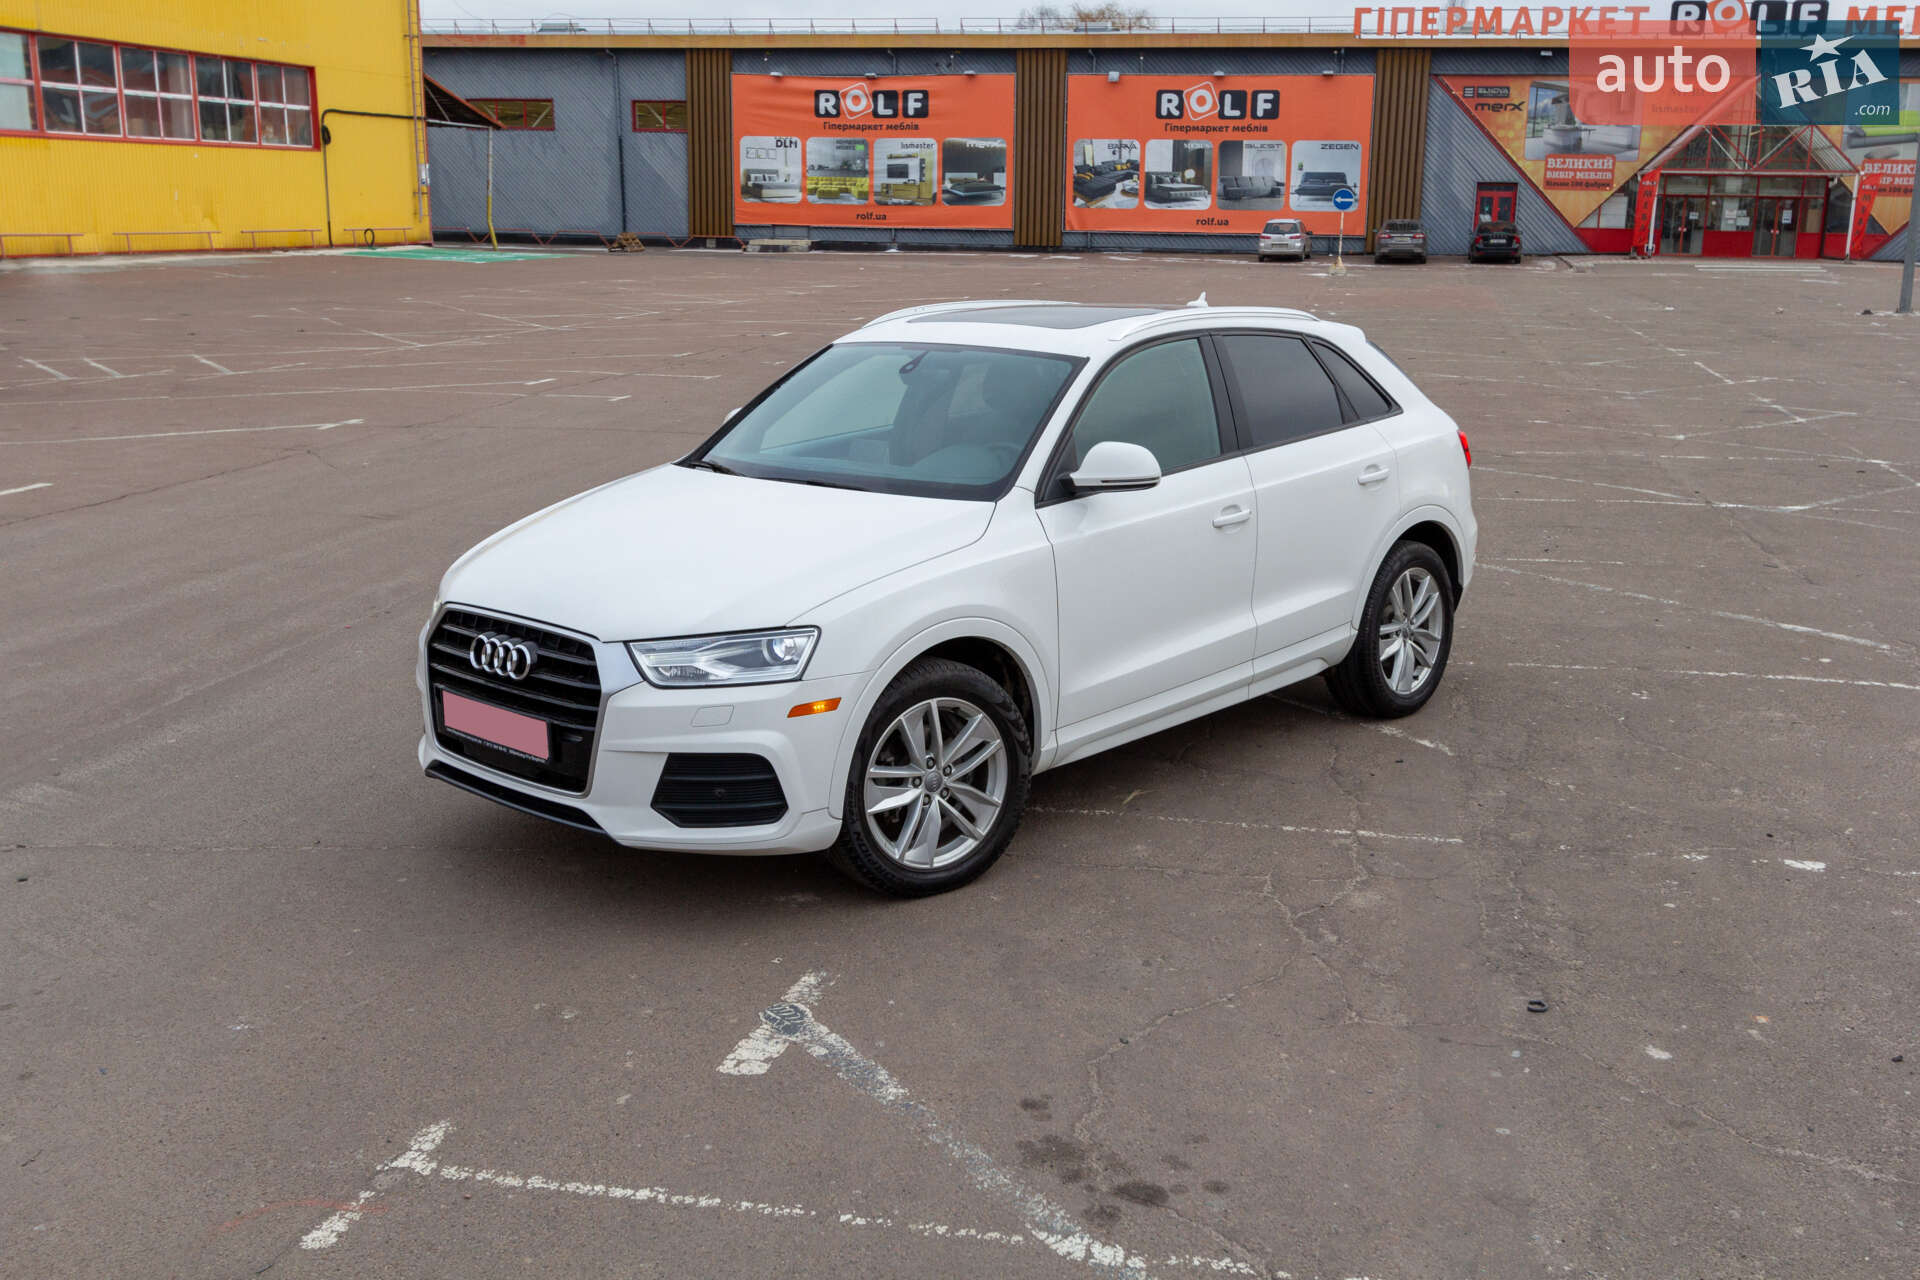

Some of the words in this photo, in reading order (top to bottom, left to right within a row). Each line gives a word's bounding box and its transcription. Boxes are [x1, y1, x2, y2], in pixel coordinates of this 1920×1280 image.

[1353, 6, 1650, 36] ГІПЕРМАРКЕТ
[1672, 1, 1827, 36] ROLF
[817, 86, 926, 117] ROLF
[1159, 87, 1276, 118] ROLF
[823, 121, 883, 132] Гіпермаркет
[886, 122, 919, 131] меблів
[1164, 122, 1229, 134] Гіпермаркет
[1232, 123, 1268, 133] меблів
[775, 139, 798, 149] DLM
[1546, 156, 1613, 169] ВЕЛИКИЙ
[1864, 163, 1916, 174] ВЕЛИК
[856, 211, 887, 221] rolf.ua
[1195, 216, 1229, 226] rolf.ua
